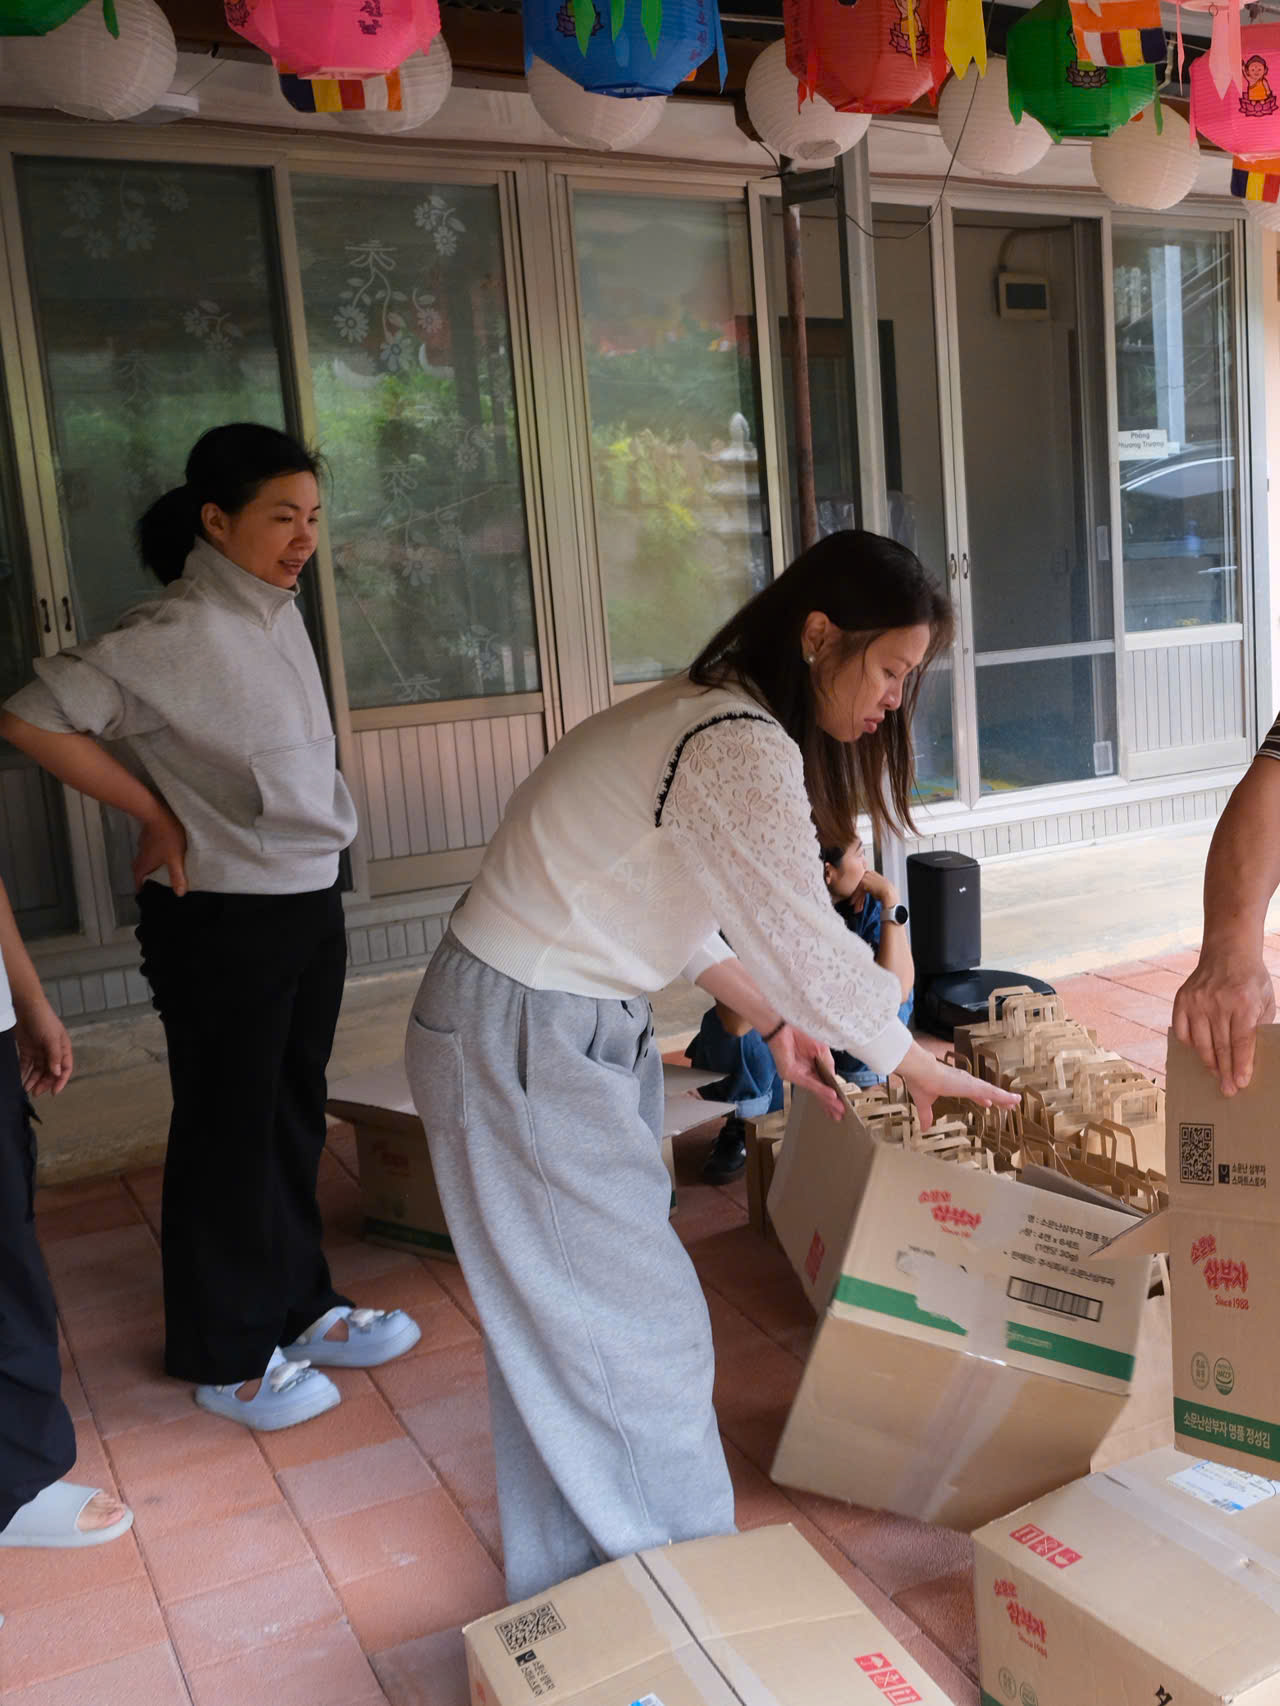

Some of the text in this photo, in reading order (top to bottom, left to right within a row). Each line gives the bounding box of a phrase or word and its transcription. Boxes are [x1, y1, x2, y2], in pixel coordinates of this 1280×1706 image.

[1203, 1257, 1249, 1293] 삼부자
[1183, 1411, 1271, 1450] 소문난삼부자 명품 정성김
